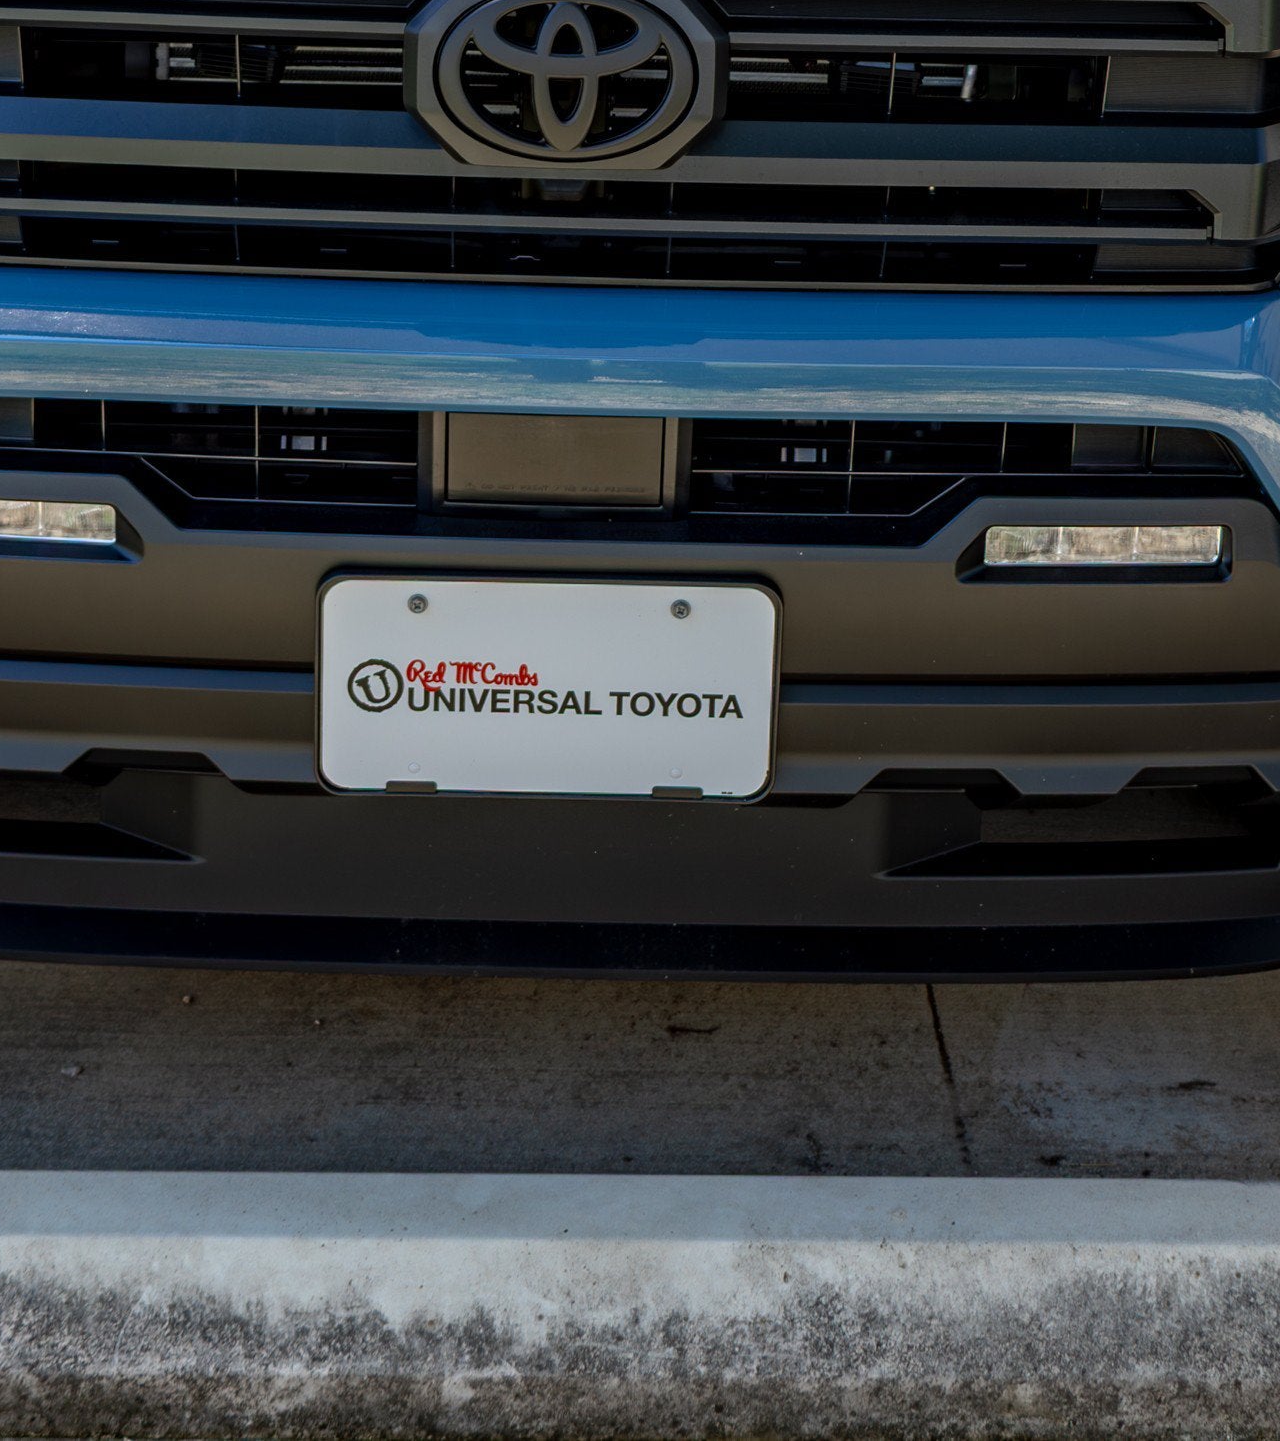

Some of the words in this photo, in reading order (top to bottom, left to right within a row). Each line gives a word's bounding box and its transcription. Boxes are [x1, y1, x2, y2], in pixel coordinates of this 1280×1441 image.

[406, 659, 447, 693] Red
[450, 661, 539, 687] McCombs
[407, 687, 603, 716] UNIVERSAL
[609, 692, 744, 719] TOYOTA
